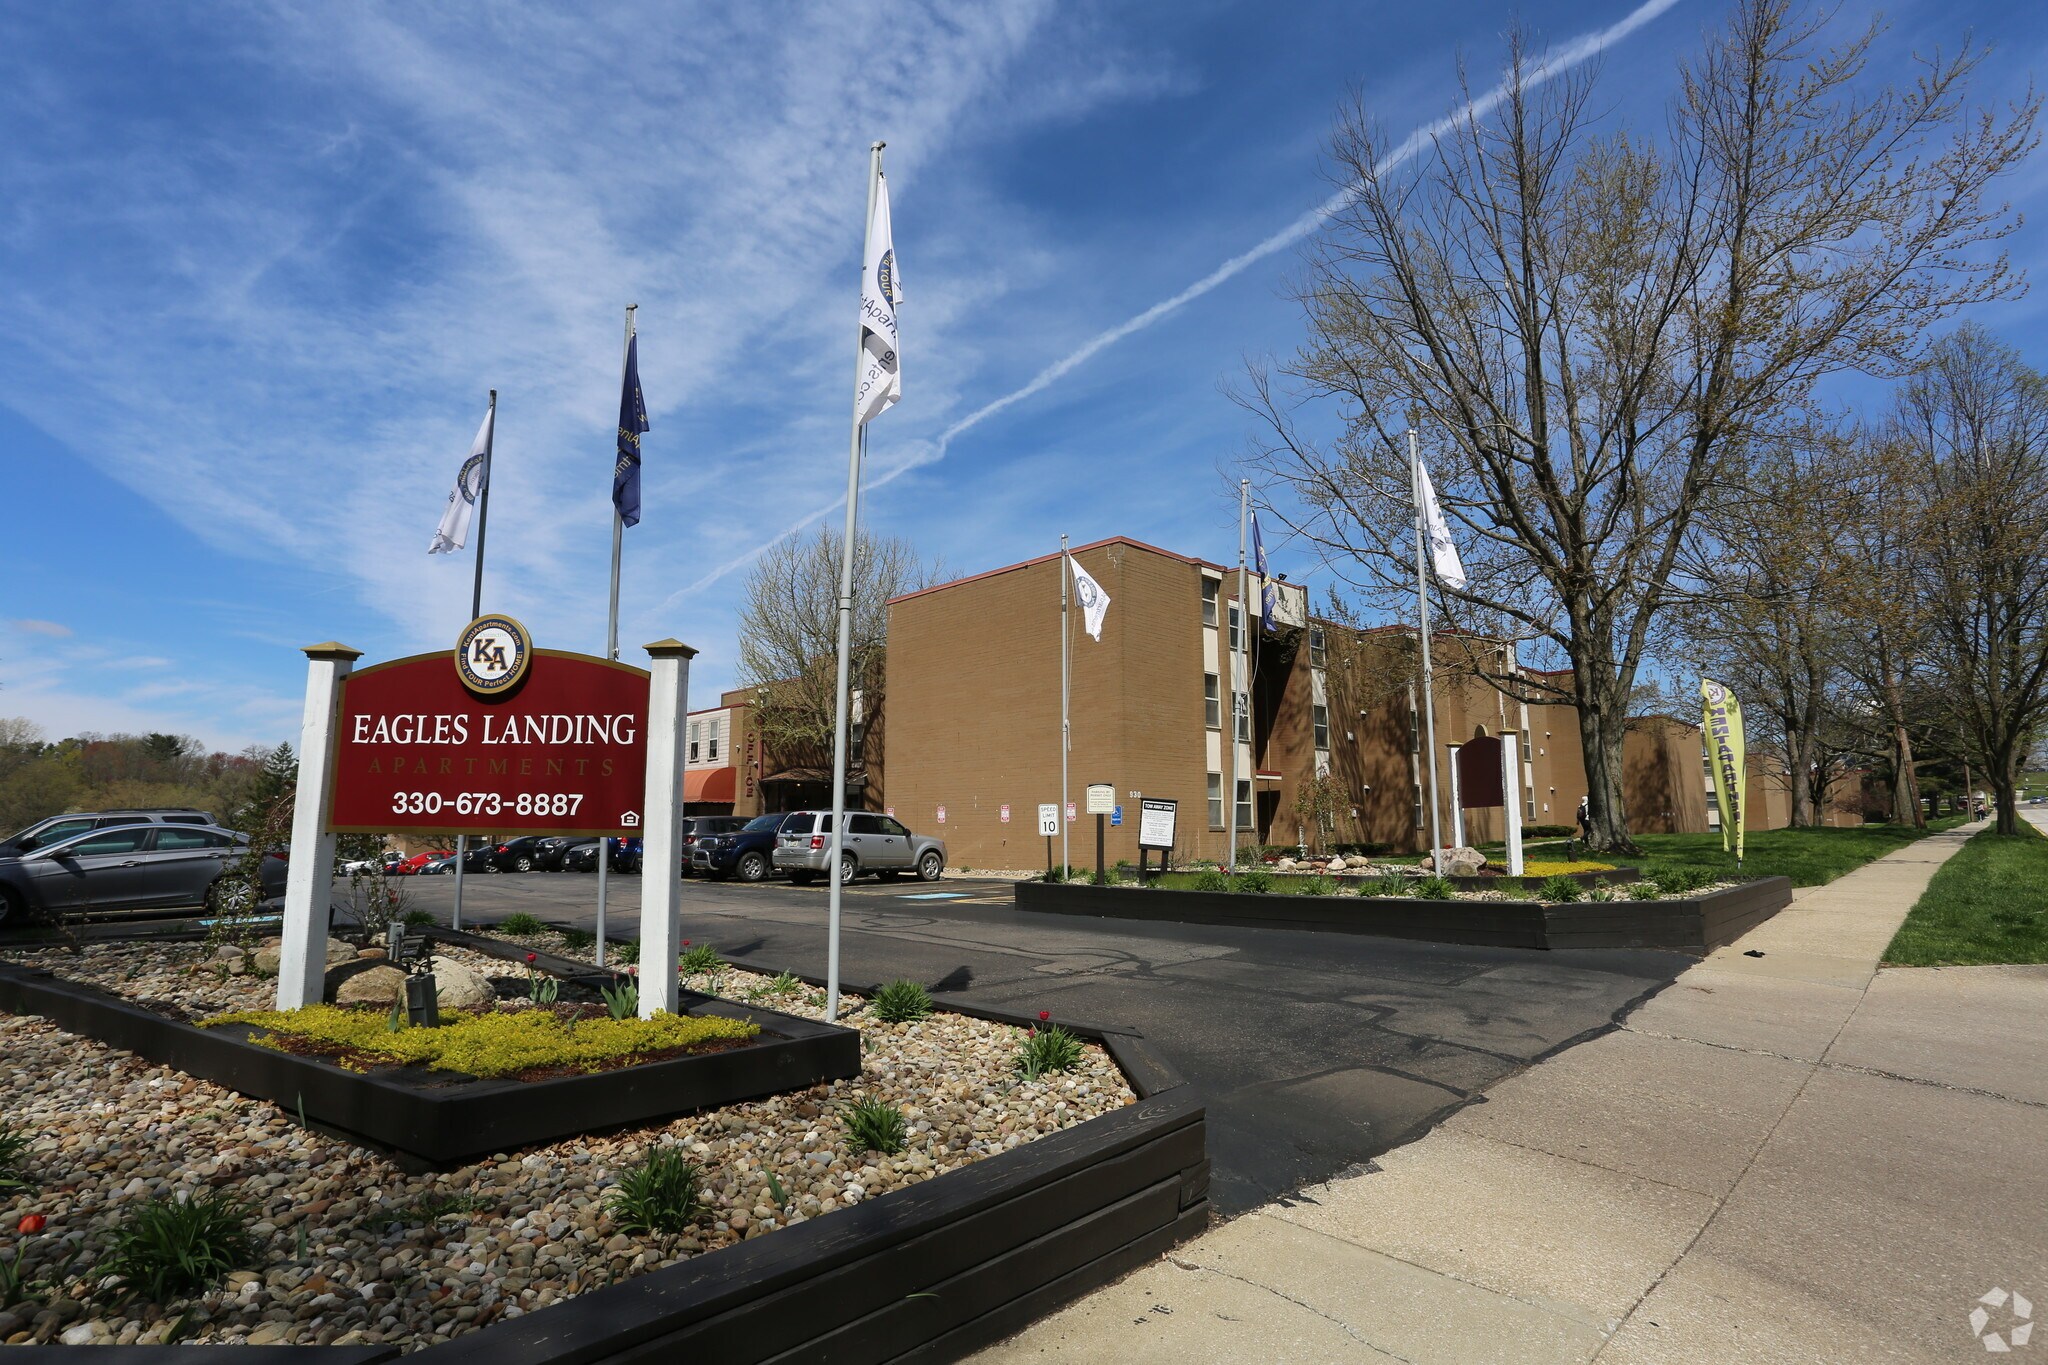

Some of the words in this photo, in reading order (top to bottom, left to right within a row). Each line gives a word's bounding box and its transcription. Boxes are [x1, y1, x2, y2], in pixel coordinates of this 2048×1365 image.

[463, 621, 521, 648] KentApartments.com
[466, 670, 483, 686] YOUR
[484, 675, 510, 687] Perfect
[509, 651, 523, 676] HOME!
[473, 638, 508, 672] KA
[352, 714, 469, 745] EAGLES
[481, 714, 636, 745] LANDING
[368, 757, 614, 777] APARTMENTS
[746, 732, 755, 798] OFFICE
[392, 792, 584, 816] 330-673-8887
[1043, 821, 1056, 832] 10
